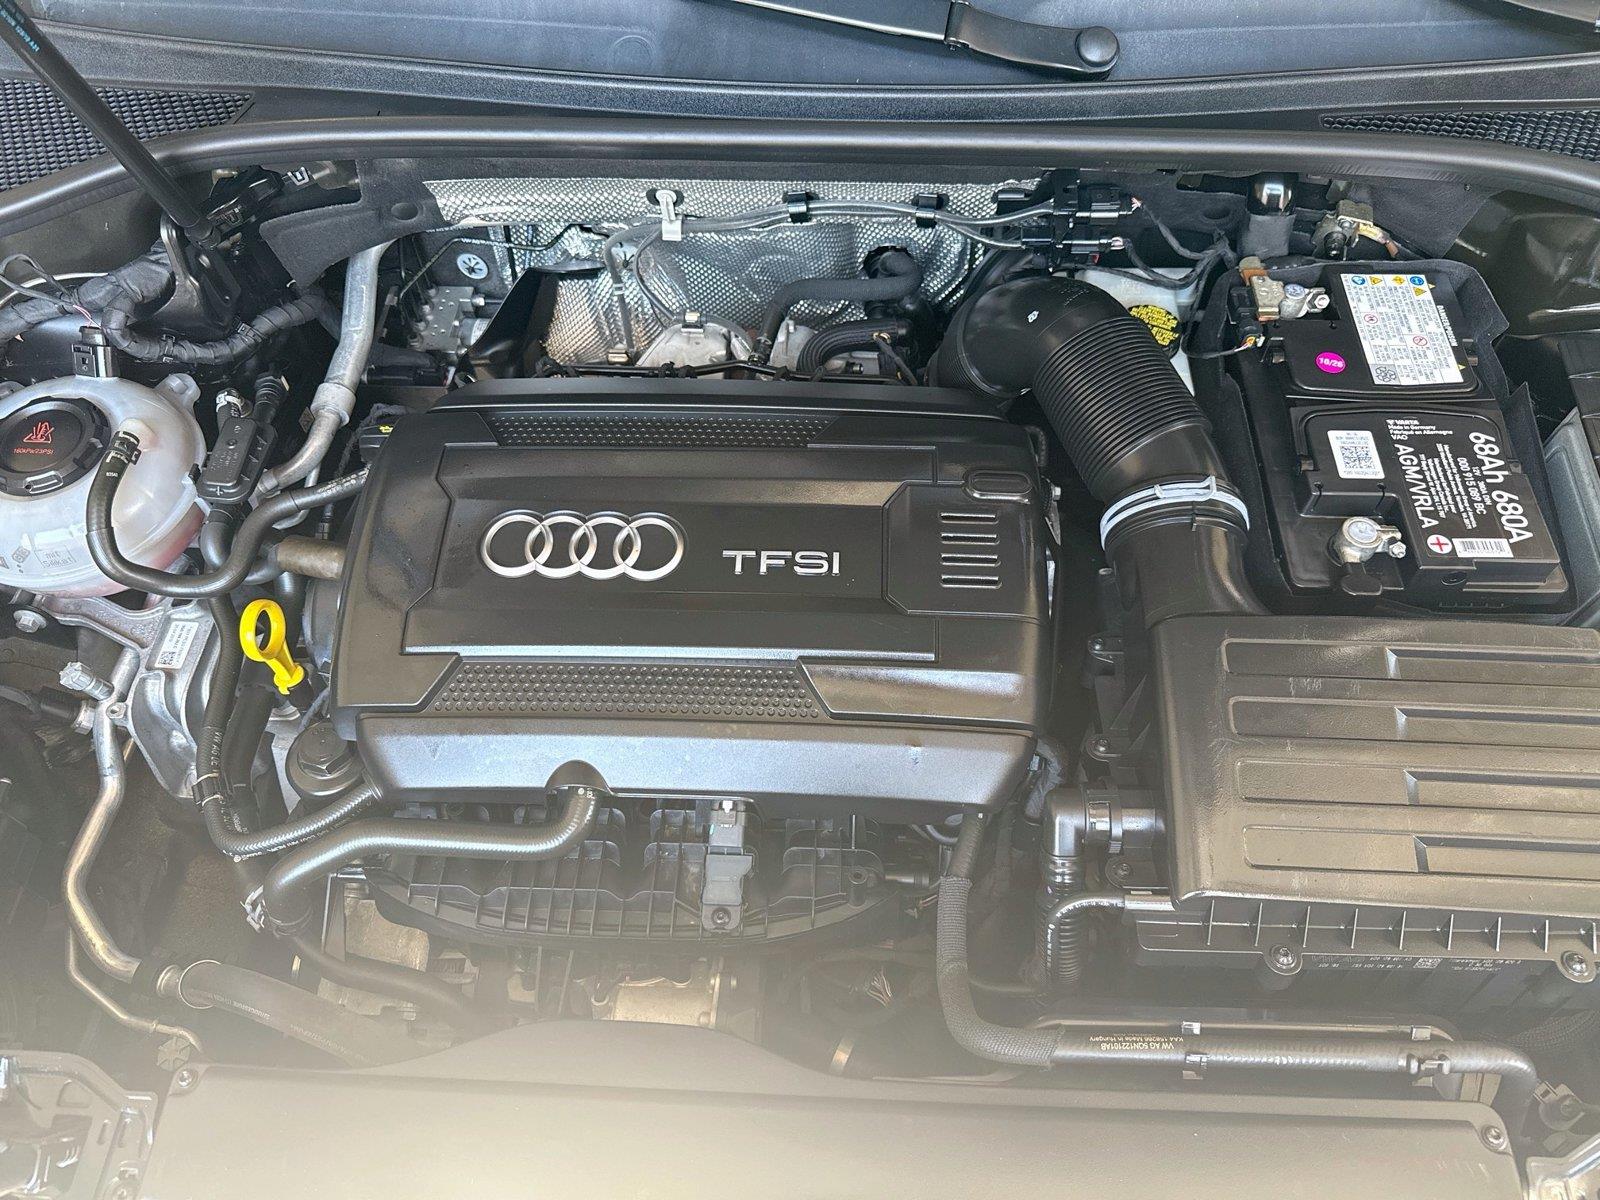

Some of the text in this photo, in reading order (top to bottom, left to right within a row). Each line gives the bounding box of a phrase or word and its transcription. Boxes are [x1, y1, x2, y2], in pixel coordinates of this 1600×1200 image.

[1394, 444, 1440, 528] AGM/VRLA
[1461, 472, 1477, 486] 915
[1468, 432, 1534, 544] 68Ah 680A
[1467, 487, 1482, 501] 089
[1473, 502, 1487, 514] BC
[722, 550, 840, 576] TFSI
